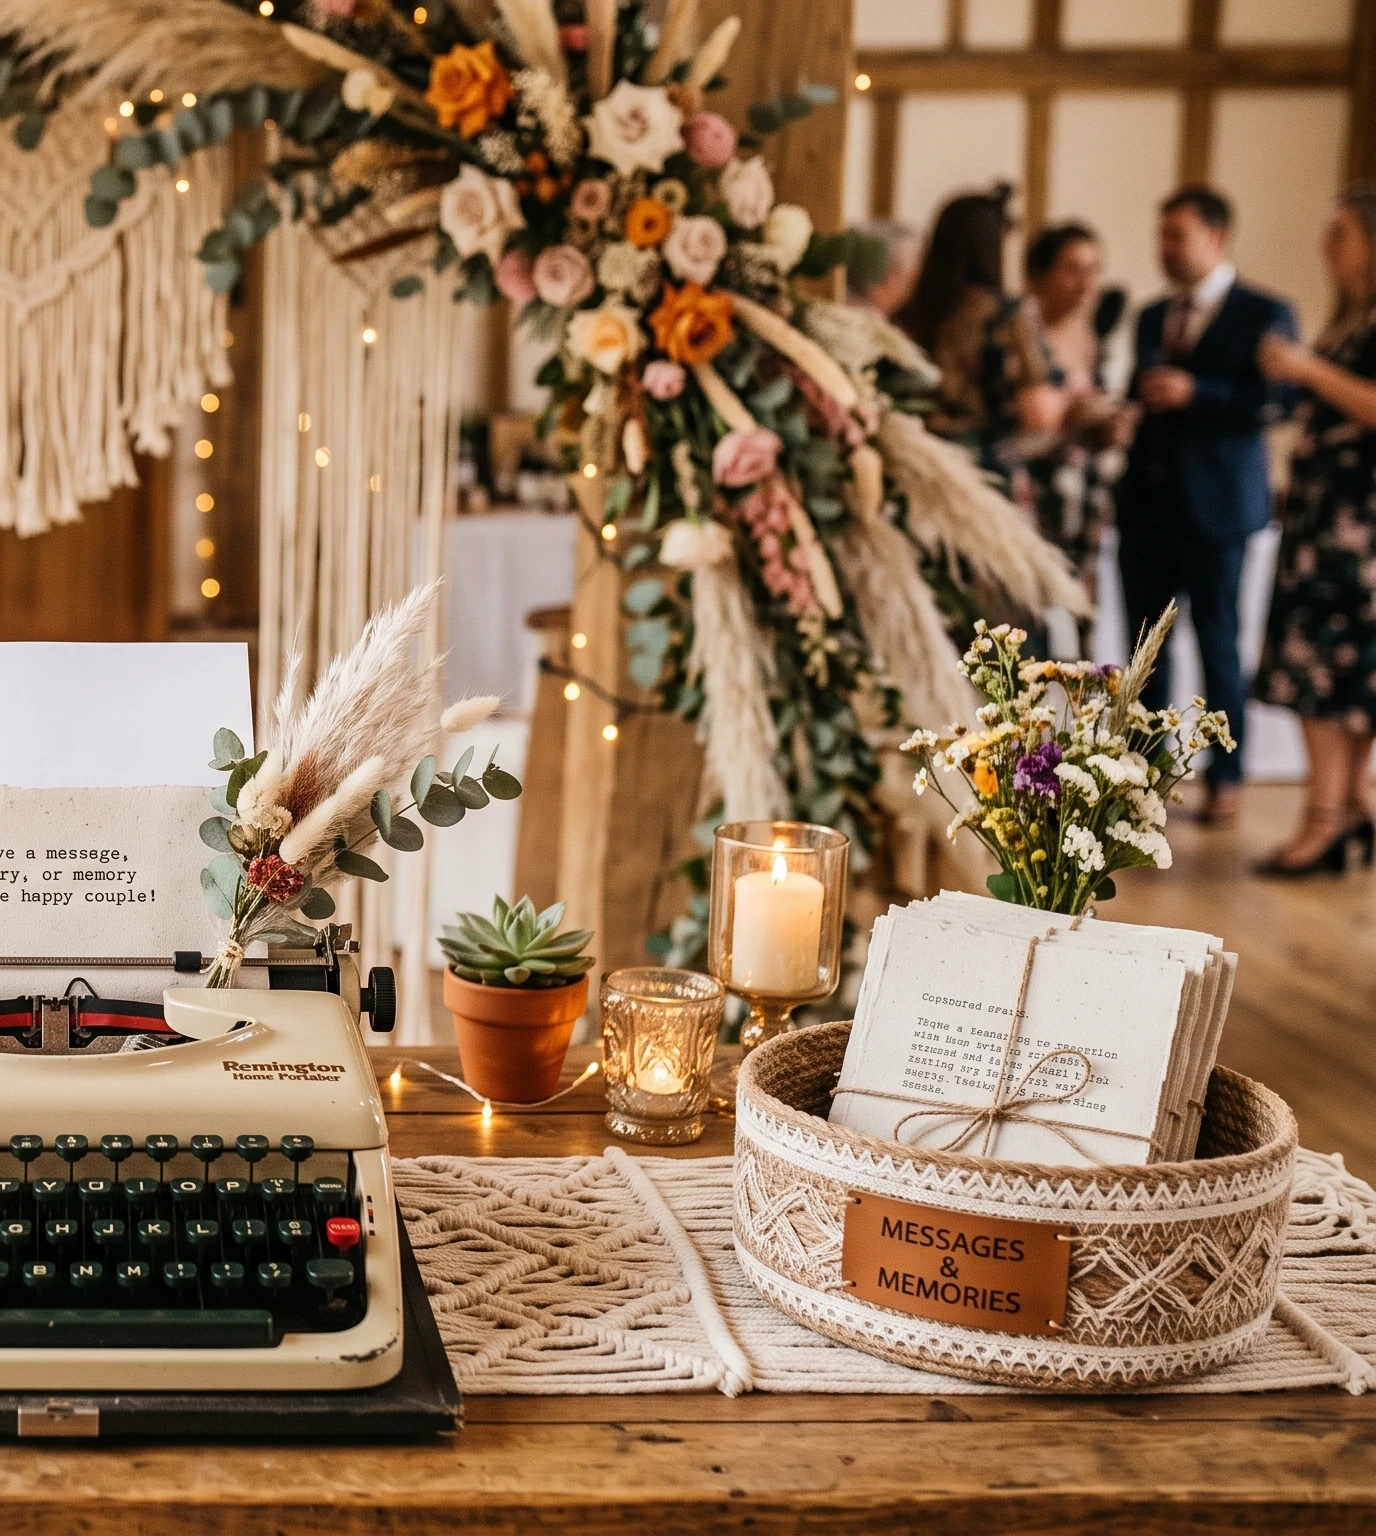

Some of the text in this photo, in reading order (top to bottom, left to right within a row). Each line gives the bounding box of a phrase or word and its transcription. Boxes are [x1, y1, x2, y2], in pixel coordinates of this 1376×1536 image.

[25, 849, 36, 860] a
[42, 870, 63, 881] or
[72, 870, 137, 885] memory
[21, 888, 74, 906] happy
[84, 889, 156, 906] couple!
[222, 1060, 346, 1074] Remington
[232, 1073, 275, 1081] Home
[42, 1181, 57, 1191] Y
[180, 1181, 197, 1191] O
[226, 1181, 240, 1191] P
[55, 1223, 70, 1234] H
[102, 1223, 114, 1234] J
[148, 1223, 162, 1234] K
[196, 1223, 210, 1234] L
[881, 1216, 1025, 1262] MESSAGES
[33, 1265, 47, 1275] B
[79, 1265, 93, 1276] N
[127, 1265, 141, 1276] M
[939, 1256, 960, 1279] &
[877, 1267, 1021, 1314] MEMORIES
